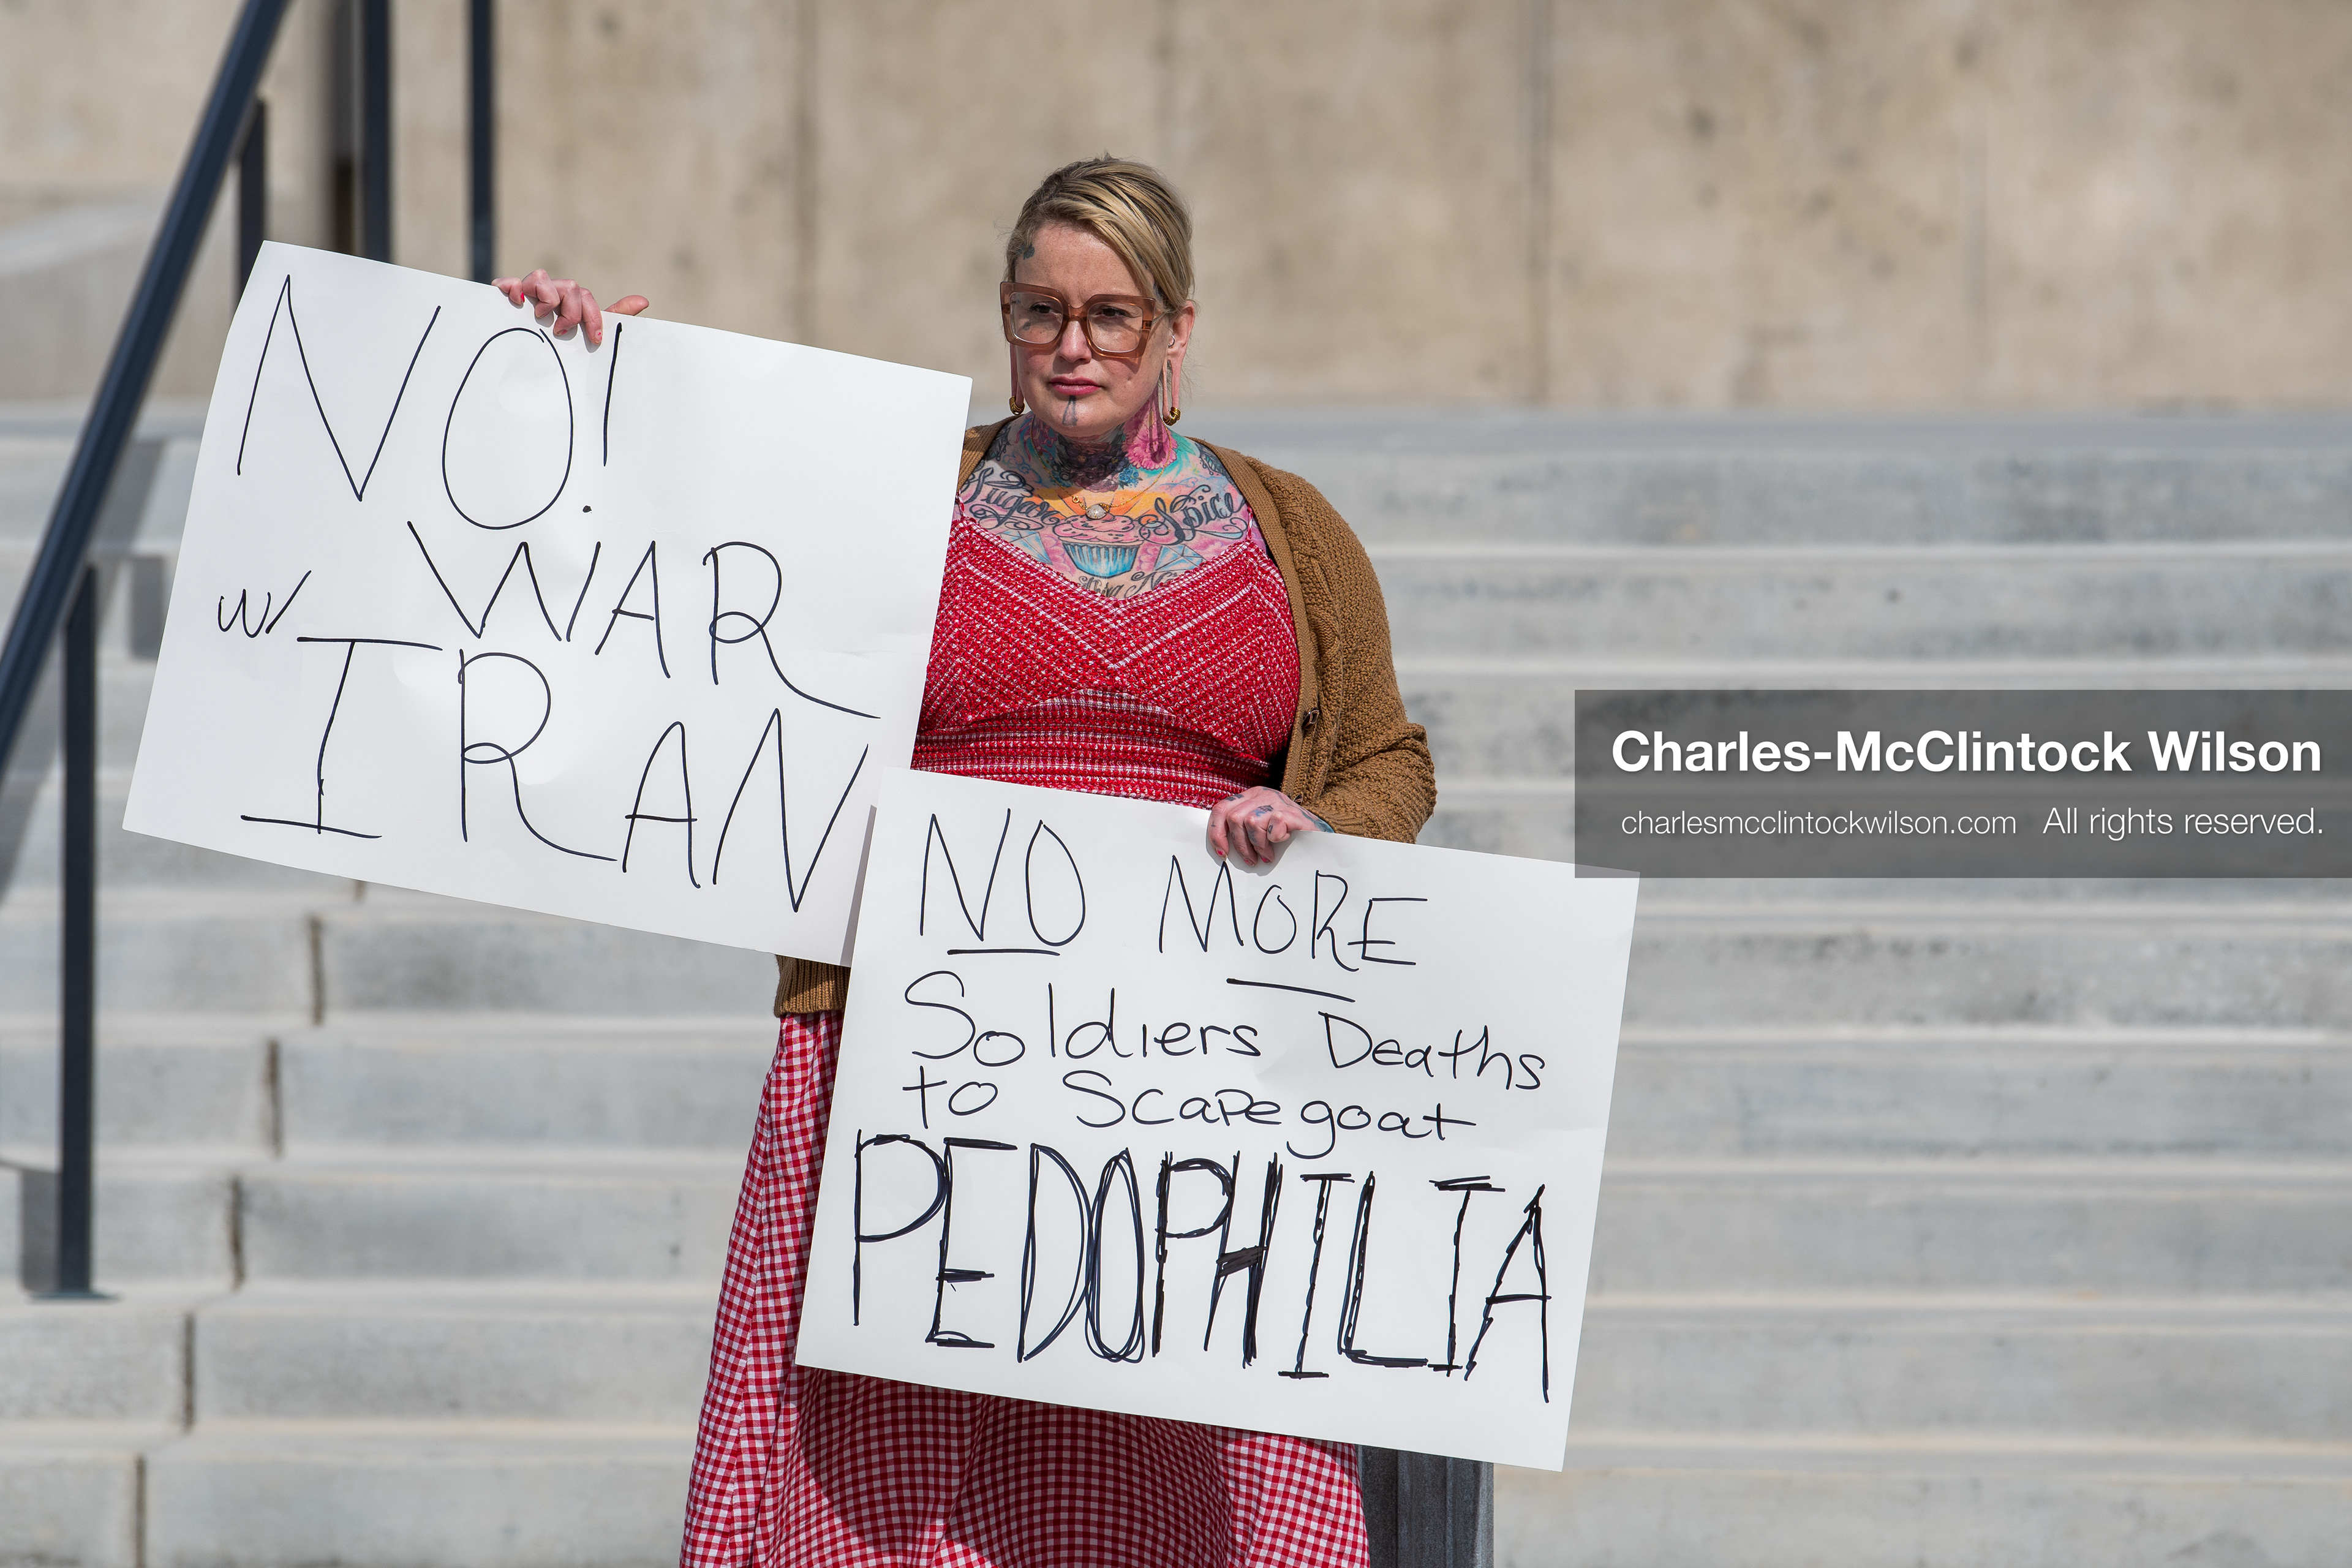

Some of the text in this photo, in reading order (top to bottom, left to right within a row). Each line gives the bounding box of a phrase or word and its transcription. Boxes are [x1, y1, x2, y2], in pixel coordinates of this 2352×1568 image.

[236, 273, 623, 530] NO!
[407, 521, 882, 719] WAR
[240, 636, 869, 913] IRAN
[919, 808, 1428, 972] NO MORE
[902, 1065, 999, 1129] to
[904, 970, 1546, 1090] Soldiers Deaths
[853, 1128, 1553, 1404] PEDOPHILIA
